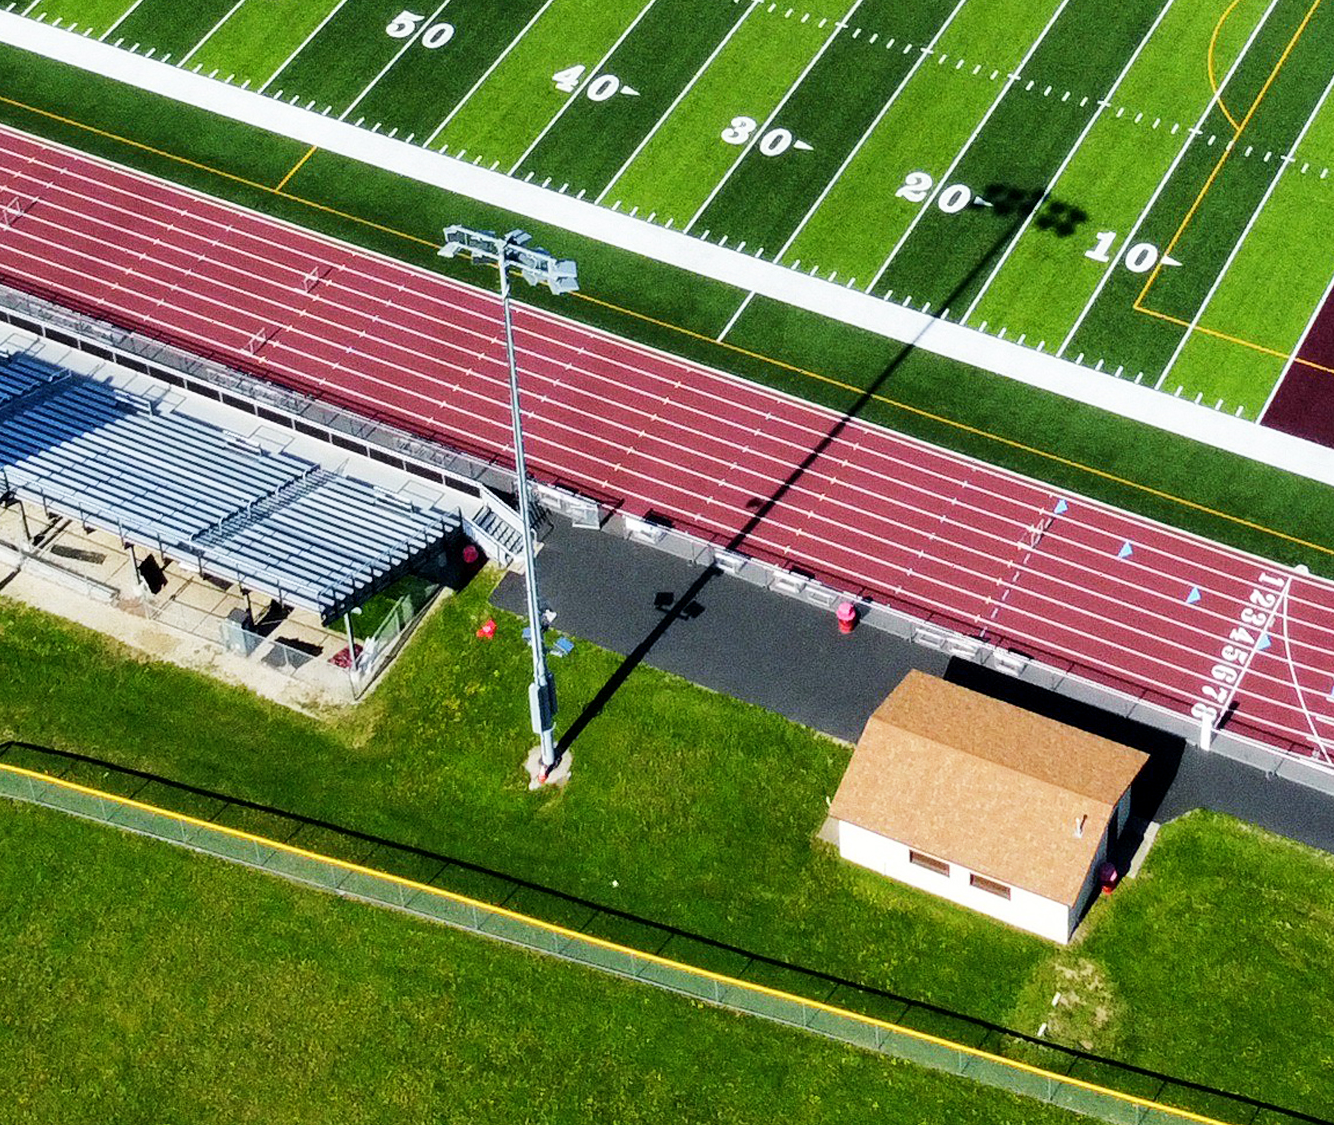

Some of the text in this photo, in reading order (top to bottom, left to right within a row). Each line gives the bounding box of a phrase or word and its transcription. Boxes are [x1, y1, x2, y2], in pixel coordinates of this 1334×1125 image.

[385, 10, 454, 49] 50
[551, 64, 620, 103] 40
[720, 116, 794, 157] 30
[895, 171, 972, 215] 20
[1084, 230, 1161, 274] 10
[1258, 572, 1284, 586] 1
[1250, 589, 1275, 607] 2
[1241, 608, 1266, 625] 3
[1229, 627, 1255, 644] 4
[1221, 645, 1249, 665] 5
[1211, 664, 1238, 683] 6
[1202, 685, 1228, 703] 7
